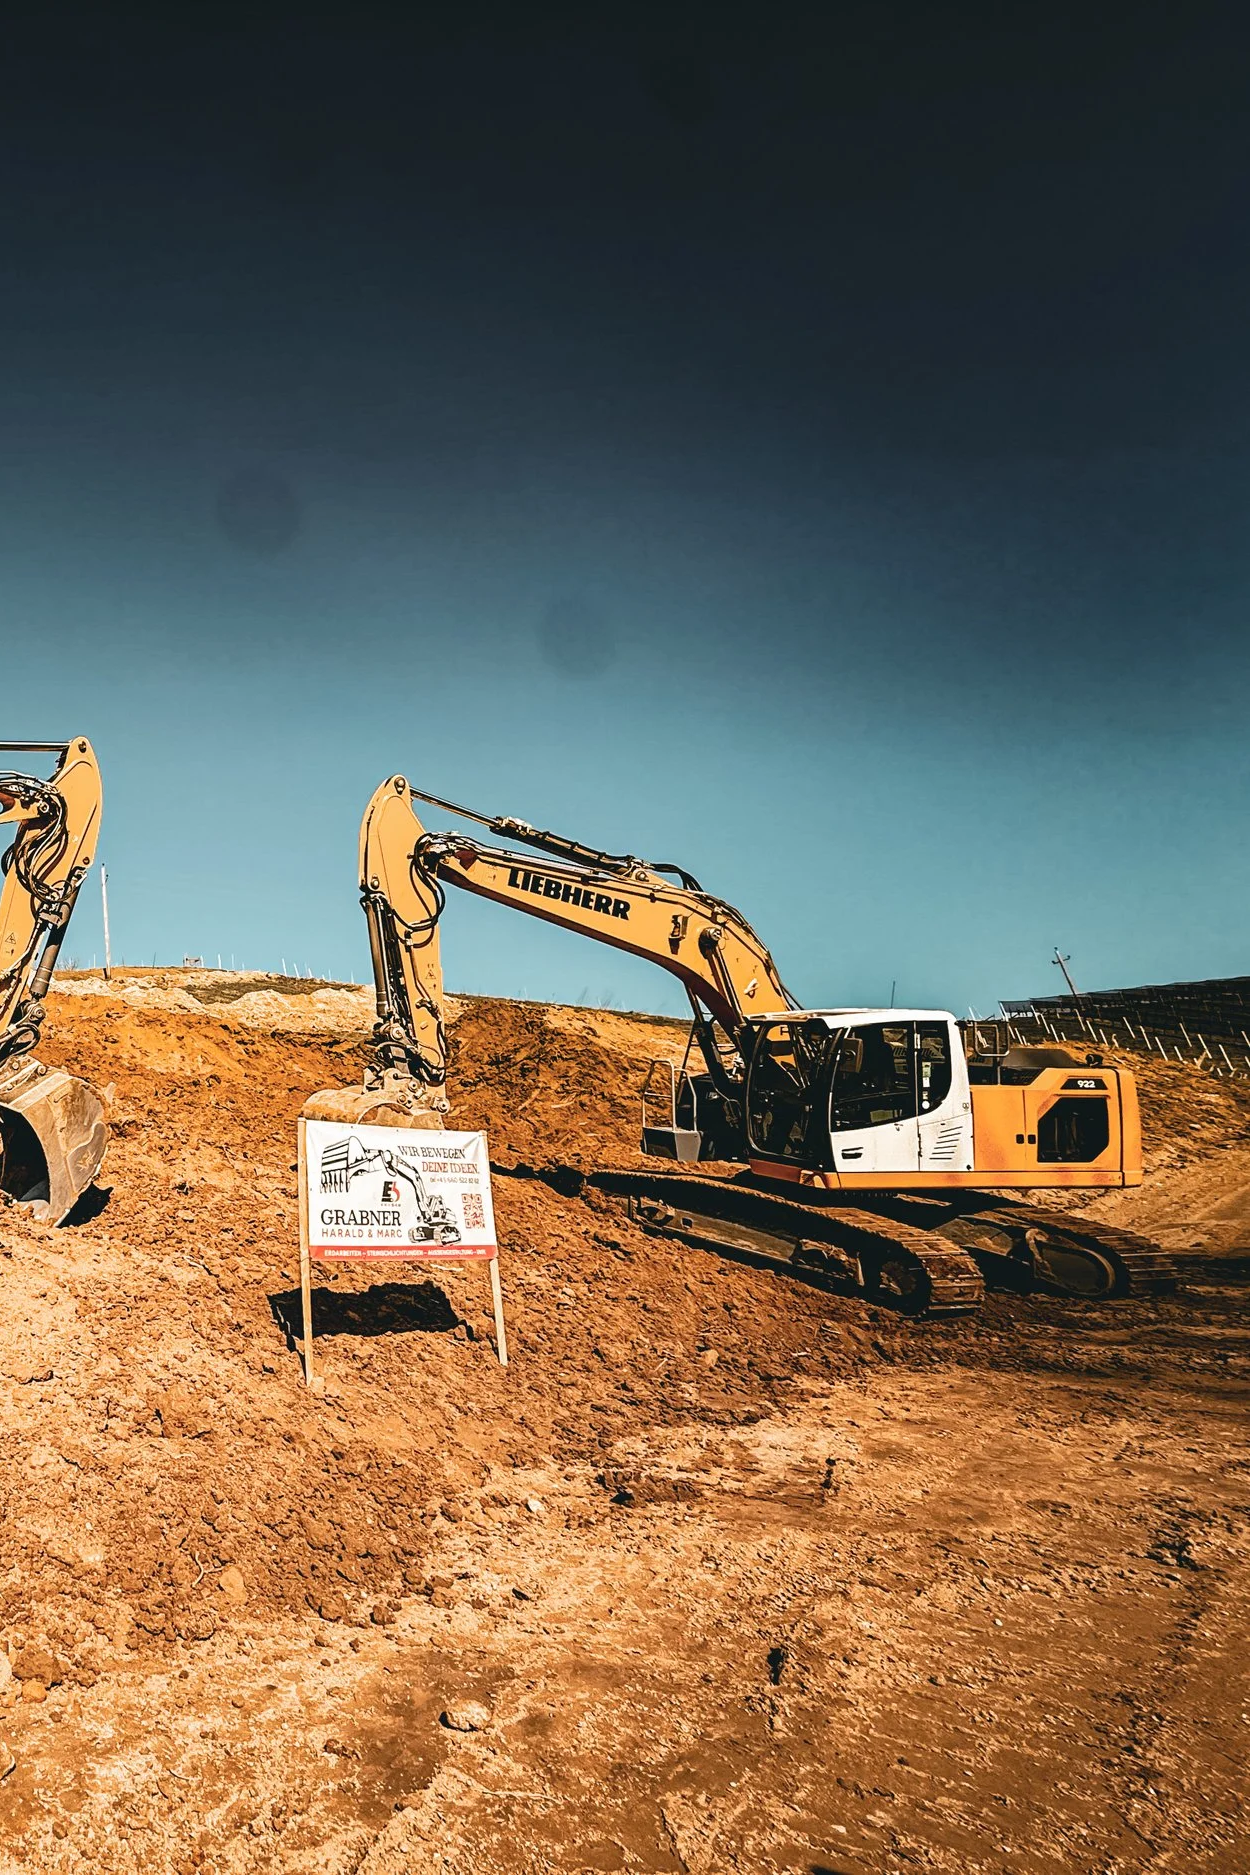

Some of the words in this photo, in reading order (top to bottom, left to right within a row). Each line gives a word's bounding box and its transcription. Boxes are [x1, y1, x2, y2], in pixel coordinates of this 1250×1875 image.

[507, 868, 631, 921] LIEBHERR
[1077, 1080, 1096, 1088] 922
[398, 1146, 420, 1157] WIR
[420, 1147, 466, 1159] BEWEGEN
[422, 1161, 449, 1173] DEINE
[321, 1209, 402, 1226] GRABNER
[322, 1228, 364, 1238] HARALD
[367, 1229, 373, 1238] &
[377, 1229, 403, 1238] MARC
